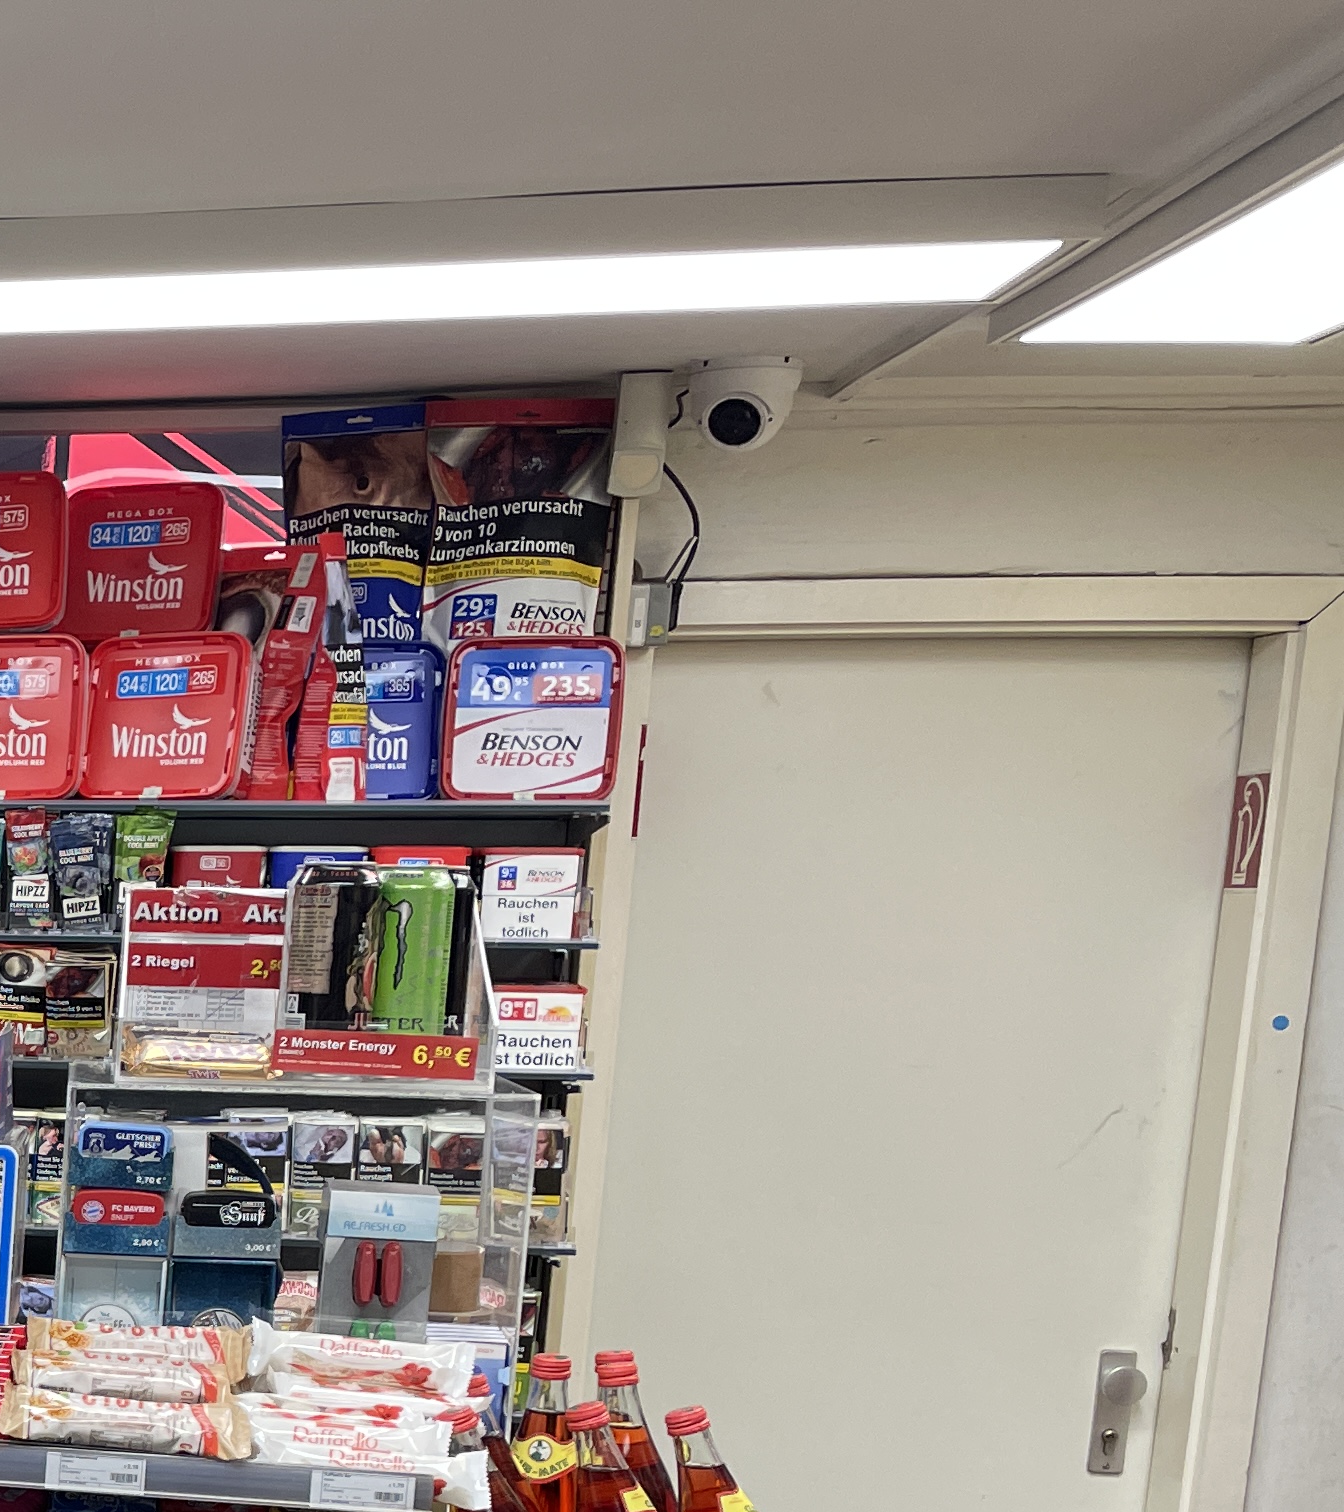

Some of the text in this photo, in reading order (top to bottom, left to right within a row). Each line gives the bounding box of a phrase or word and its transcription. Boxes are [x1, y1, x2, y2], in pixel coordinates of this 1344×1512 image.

[438, 499, 584, 523] Rauchen verursacht
[289, 506, 429, 533] Rauchen verursacht
[342, 523, 400, 539] Rachen-
[434, 523, 496, 542] 9 von 10
[430, 540, 575, 563] Lungenkarzinomen
[112, 723, 207, 757] Winston
[481, 732, 582, 752] BENSON
[15, 884, 47, 898] HIPZZ
[498, 898, 558, 909] Rauchen
[134, 901, 219, 923] Aktion
[518, 913, 534, 923] ist
[502, 927, 548, 938] tödlich
[131, 954, 195, 970] 2 Riegel
[280, 1037, 396, 1055] 2 Monster Energy
[497, 1035, 572, 1048] Rauchen
[516, 1052, 574, 1066] tödlich
[116, 1132, 161, 1142] GLETSCHER
[123, 1205, 155, 1213] BAYERN
[319, 1338, 403, 1360] Raffaello
